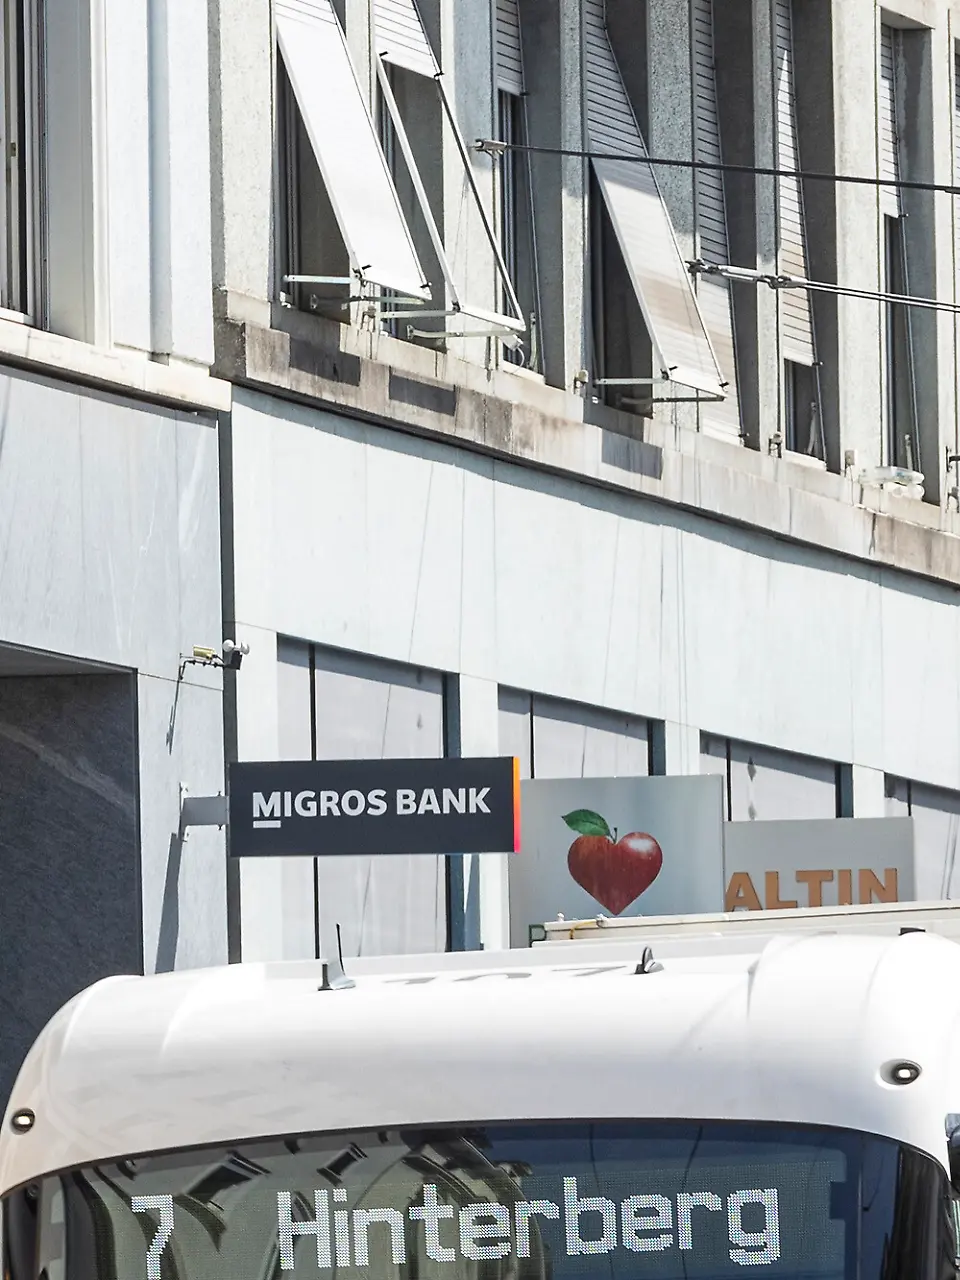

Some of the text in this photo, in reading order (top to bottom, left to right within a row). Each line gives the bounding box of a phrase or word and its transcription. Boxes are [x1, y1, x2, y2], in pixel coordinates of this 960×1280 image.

[252, 787, 491, 821] MIGROS BANK
[725, 868, 898, 912] ALTIN
[277, 1176, 781, 1267] Hinterberg
